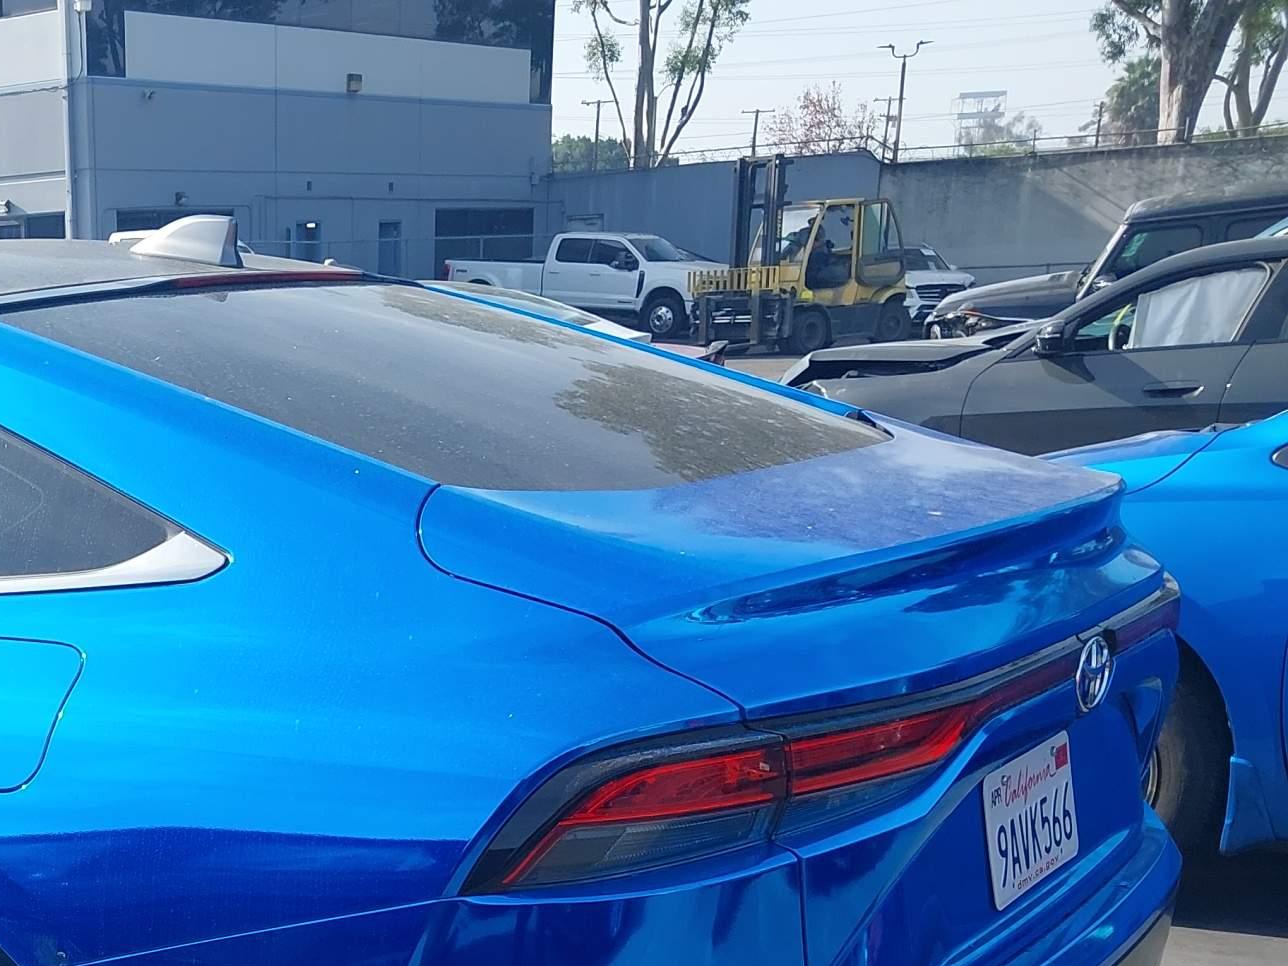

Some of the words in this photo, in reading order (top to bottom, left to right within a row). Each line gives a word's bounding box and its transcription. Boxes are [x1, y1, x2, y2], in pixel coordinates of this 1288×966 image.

[991, 787, 1002, 808] APR
[1001, 762, 1057, 808] California
[997, 781, 1073, 888] 9AVK566
[1017, 854, 1059, 890] dmv.ca.gov
